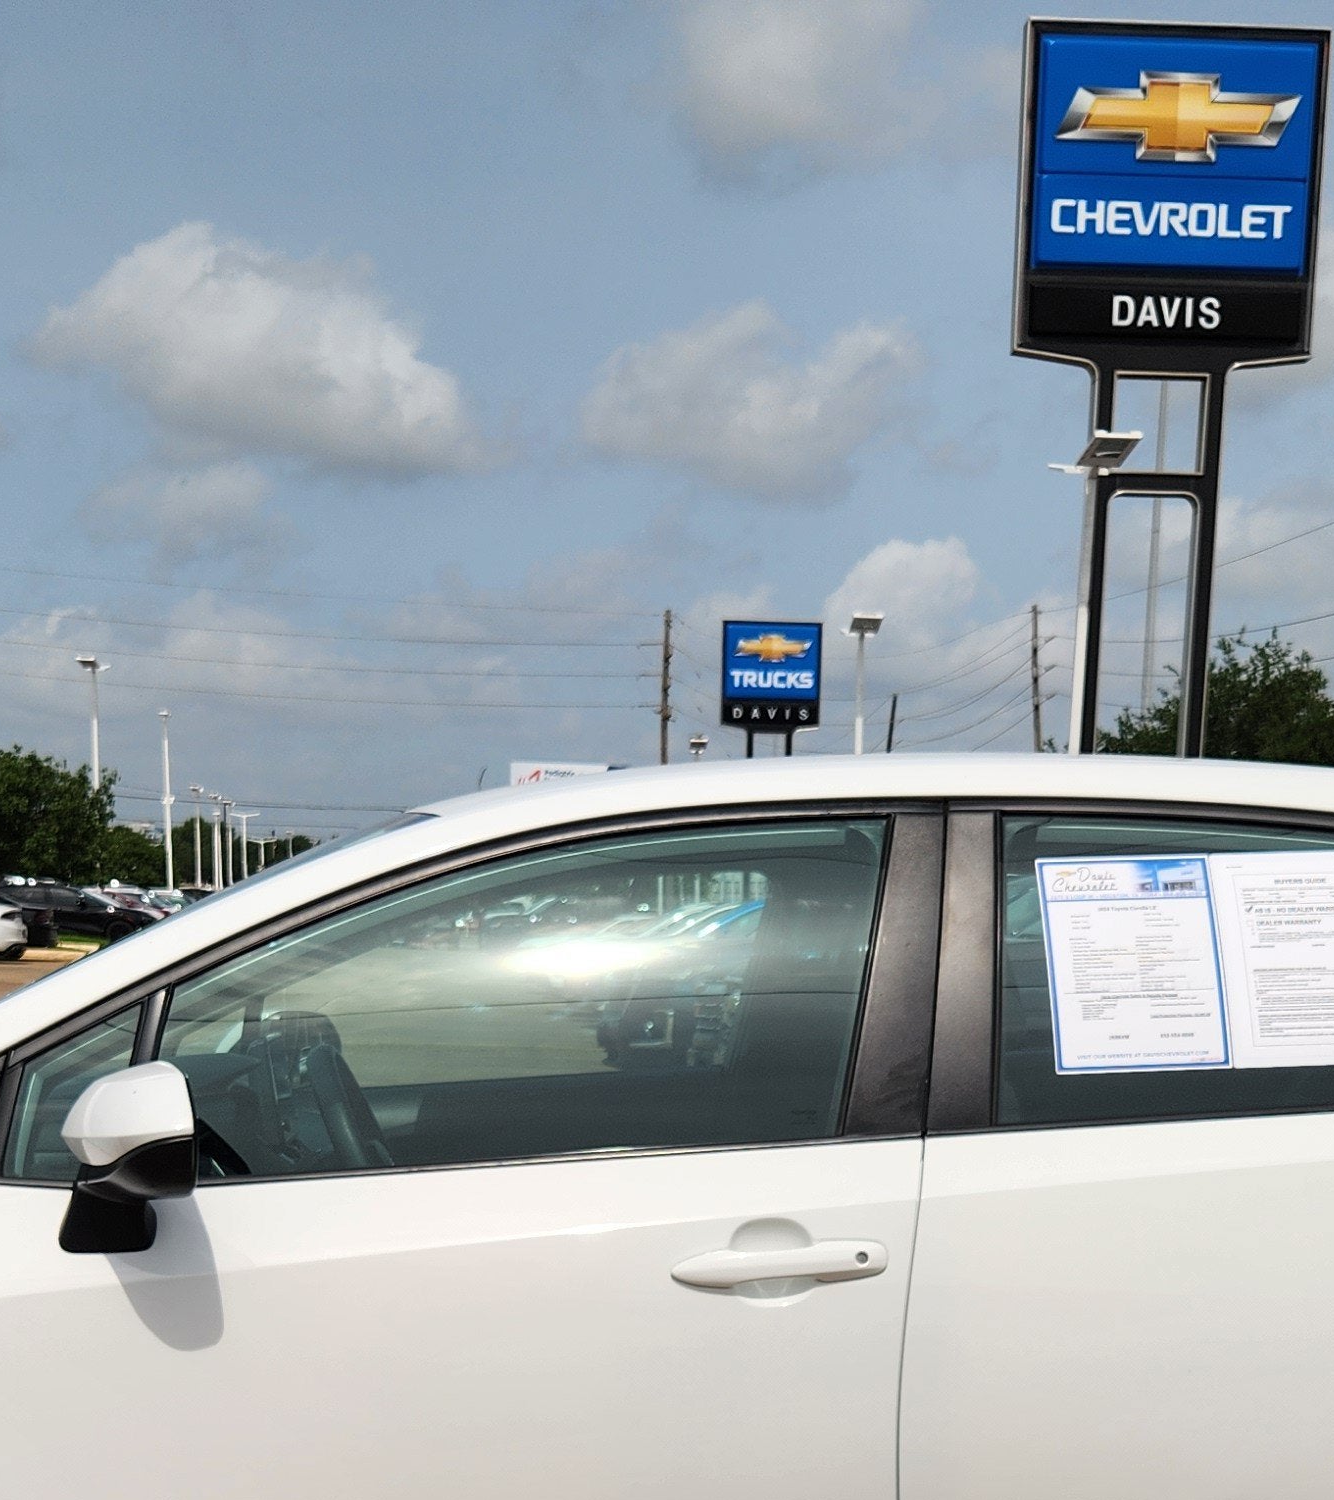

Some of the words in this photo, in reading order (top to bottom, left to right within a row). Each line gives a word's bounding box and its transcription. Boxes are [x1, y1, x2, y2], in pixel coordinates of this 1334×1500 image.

[1049, 198, 1293, 240] CHEVROLET
[1111, 294, 1222, 330] DAVIS
[730, 669, 815, 689] TRUCKS
[732, 705, 810, 721] DAVIS
[1077, 867, 1116, 881] Davis
[1051, 878, 1119, 893] Chevrolet
